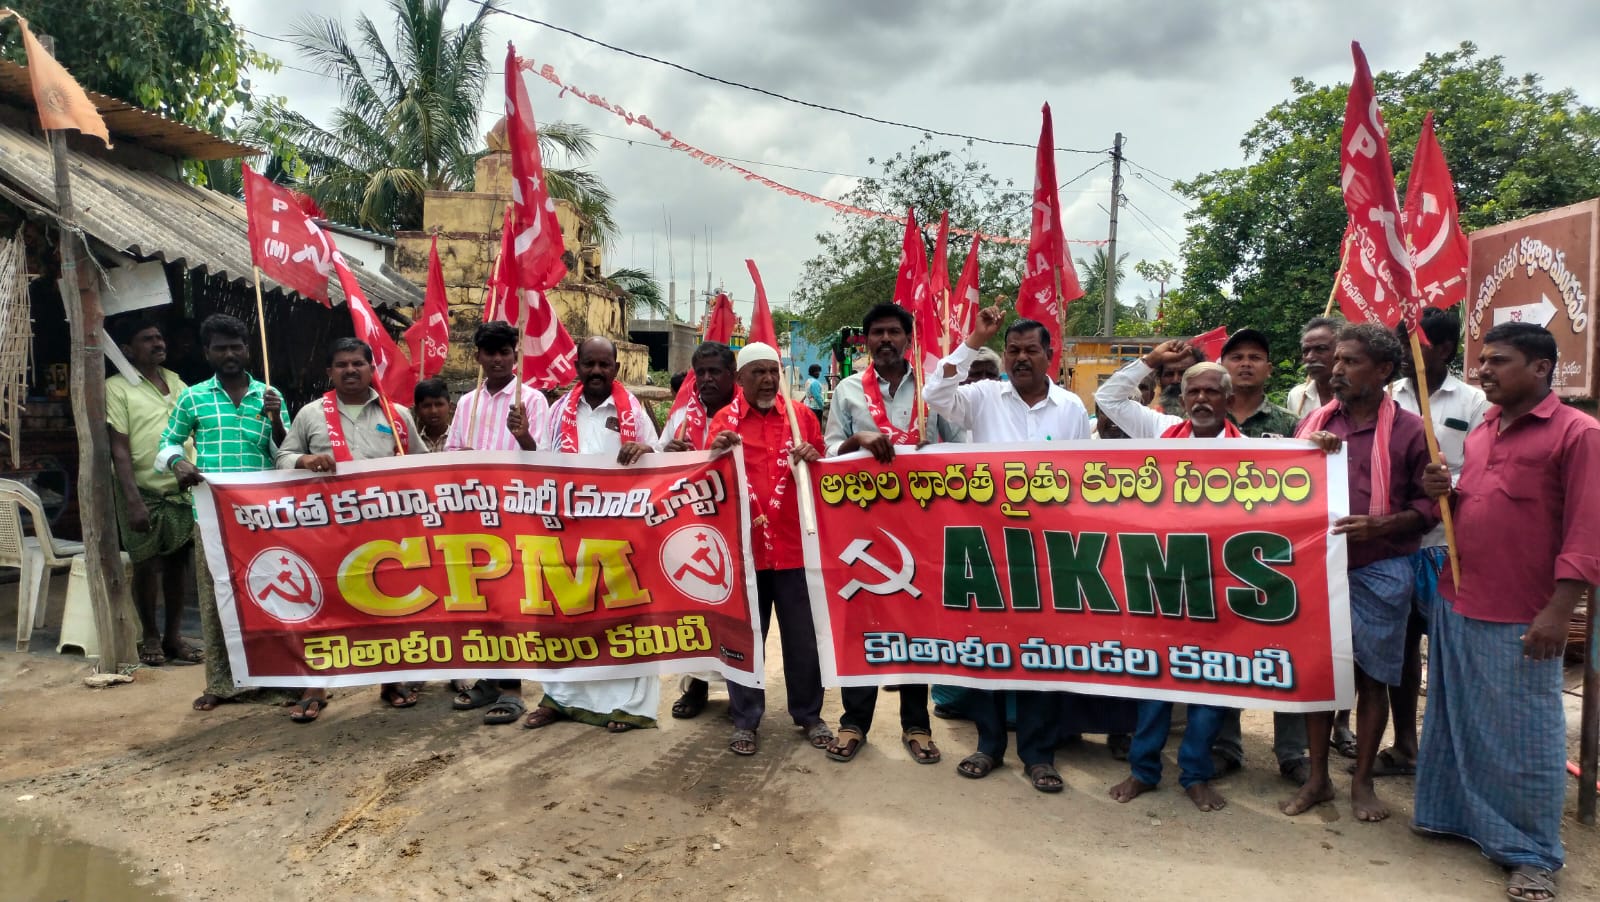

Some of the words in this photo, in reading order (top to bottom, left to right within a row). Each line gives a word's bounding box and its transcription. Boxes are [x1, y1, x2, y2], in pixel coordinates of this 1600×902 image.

[232, 493, 329, 531] భారత
[331, 478, 499, 527] కమ్యూనిస్టు
[820, 471, 901, 508] అఖిల
[908, 463, 995, 509] భారత
[1000, 462, 1070, 517] రైతు
[1081, 456, 1163, 503] కూలీ
[1173, 461, 1311, 511] సంఘం
[337, 534, 651, 616] CPM
[942, 525, 1297, 622] AIKMS
[303, 631, 452, 670] కౌతాళం
[461, 629, 599, 662] మండలం
[863, 631, 1011, 668] కౌతాళం
[1019, 637, 1159, 676] మండల
